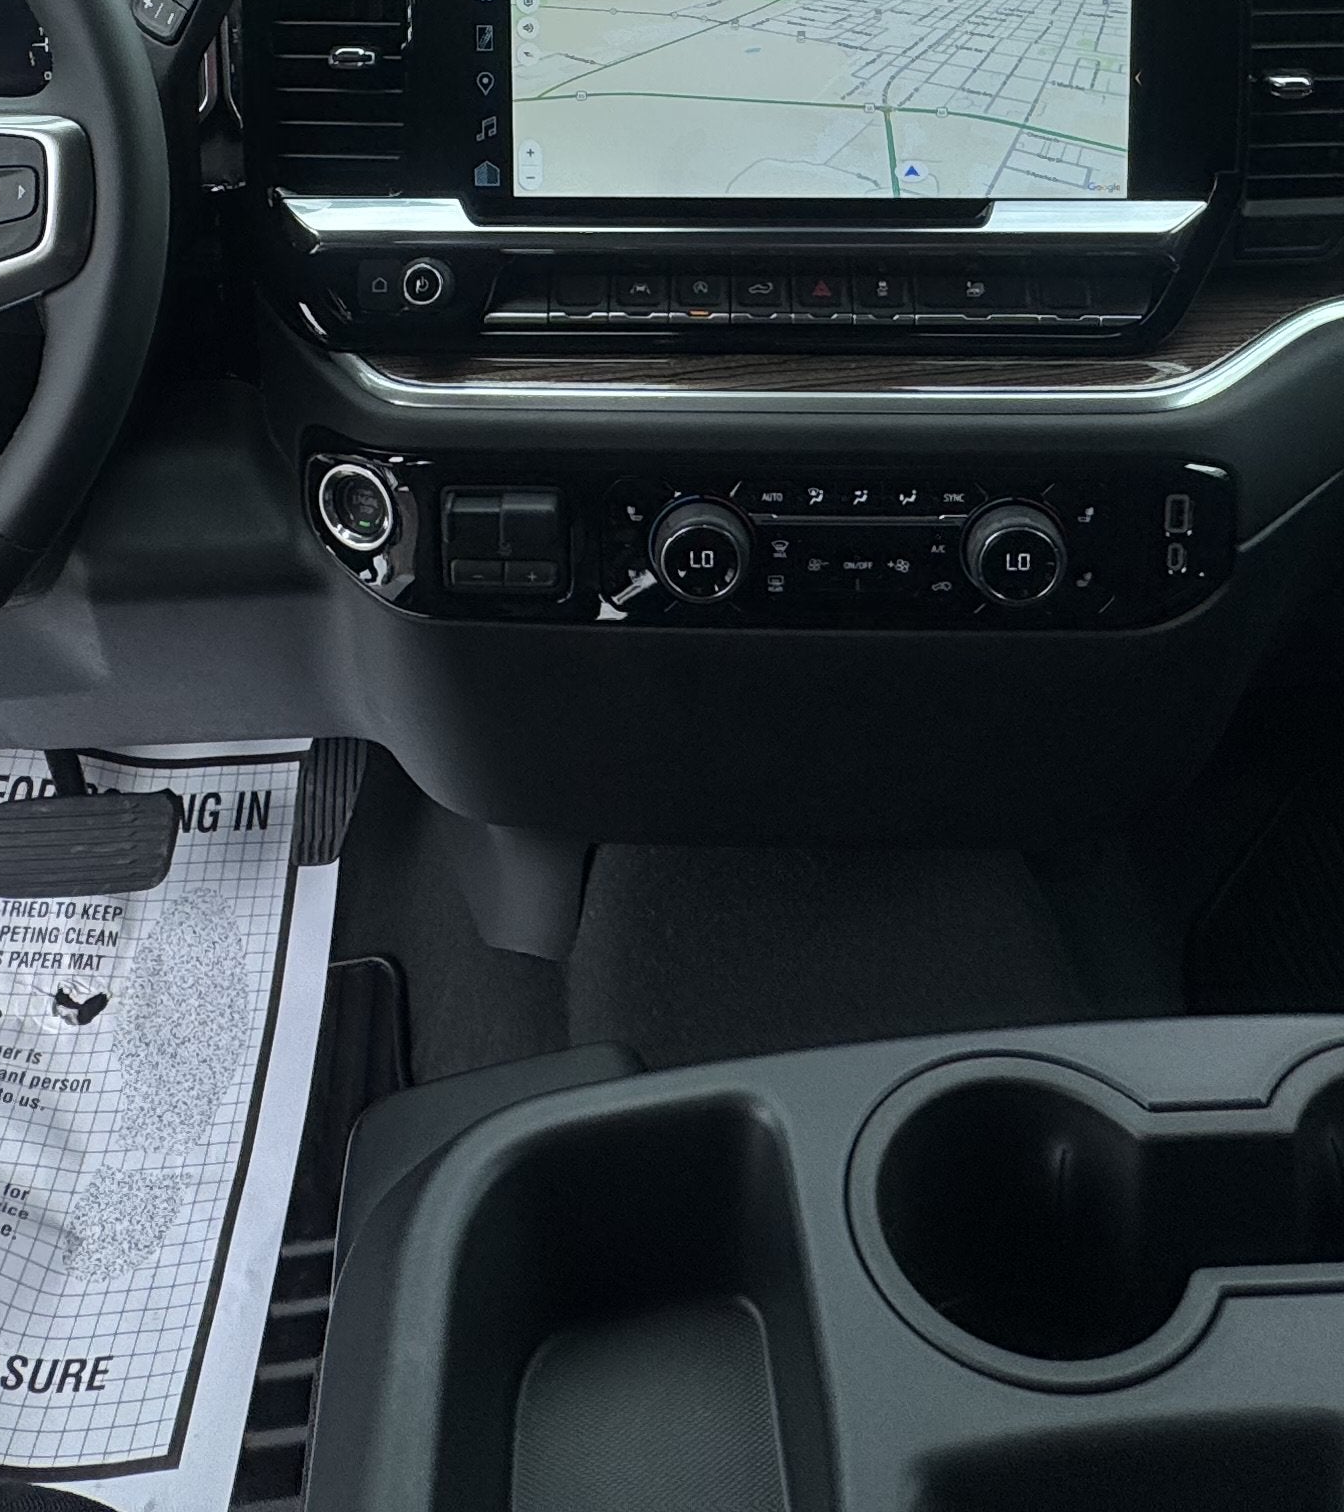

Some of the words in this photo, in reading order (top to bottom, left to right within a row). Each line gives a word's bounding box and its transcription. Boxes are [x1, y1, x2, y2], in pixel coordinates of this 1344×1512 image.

[1088, 181, 1120, 193] Google
[761, 492, 783, 502] AUTO
[943, 493, 965, 503] SYNC
[689, 550, 714, 568] LO
[843, 561, 873, 570] ON/OFF
[1006, 553, 1031, 571] LO
[234, 790, 271, 831] IN
[1, 900, 49, 918] TRIED
[56, 901, 76, 920] TO
[81, 903, 123, 921] KEEP
[64, 926, 119, 947] CLEAN
[8, 951, 62, 970] PAPER
[68, 953, 105, 971] MAT
[26, 1048, 42, 1065] is
[29, 1076, 92, 1094] person
[19, 1094, 46, 1111] us.
[3, 1183, 30, 1201] for
